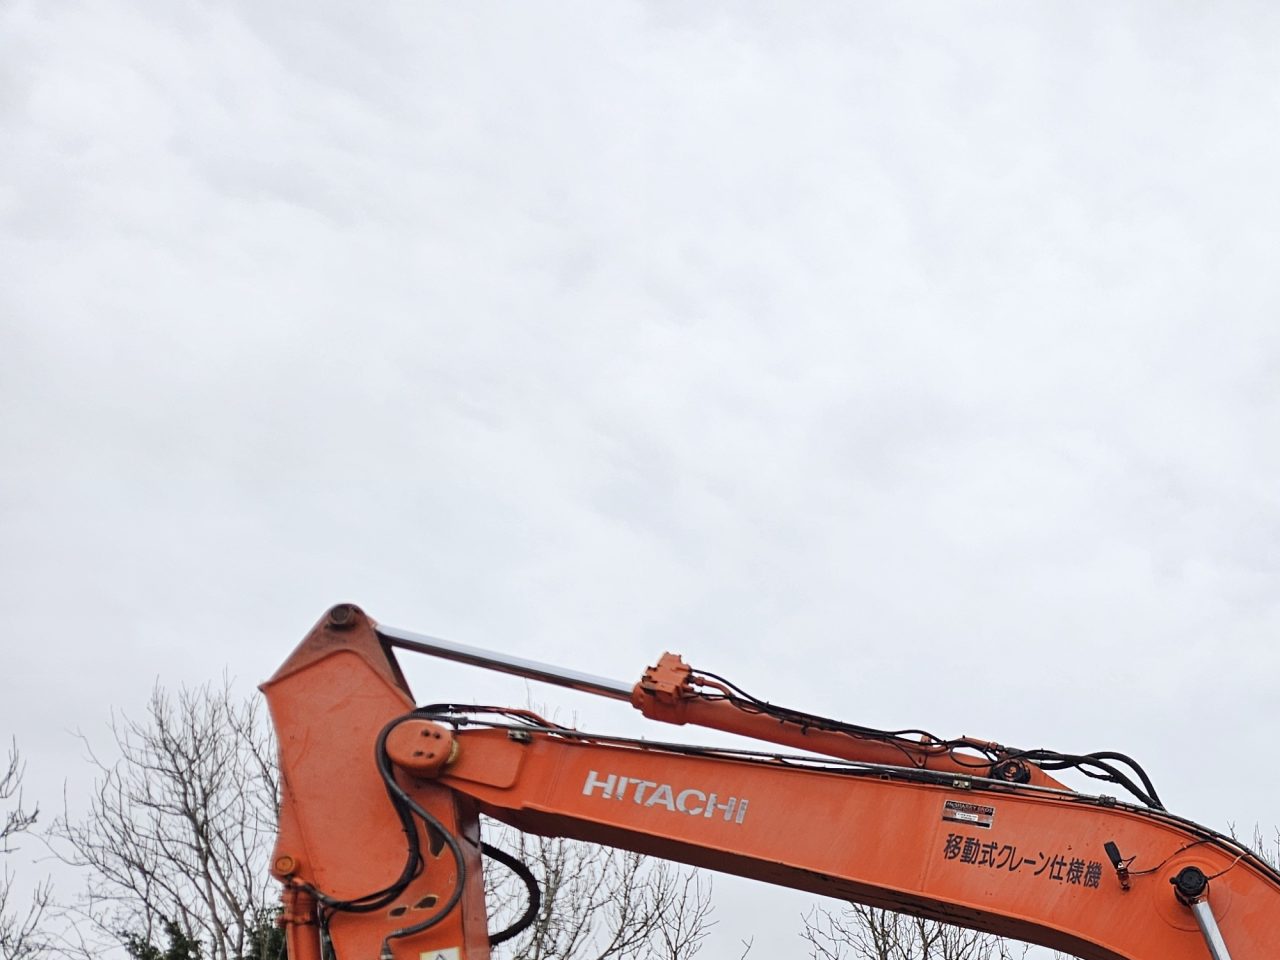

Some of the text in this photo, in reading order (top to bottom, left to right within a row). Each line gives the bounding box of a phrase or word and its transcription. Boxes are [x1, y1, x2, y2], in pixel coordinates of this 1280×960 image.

[582, 770, 749, 824] HITACHI
[943, 833, 1102, 889] 移動式クレーン仕様機
